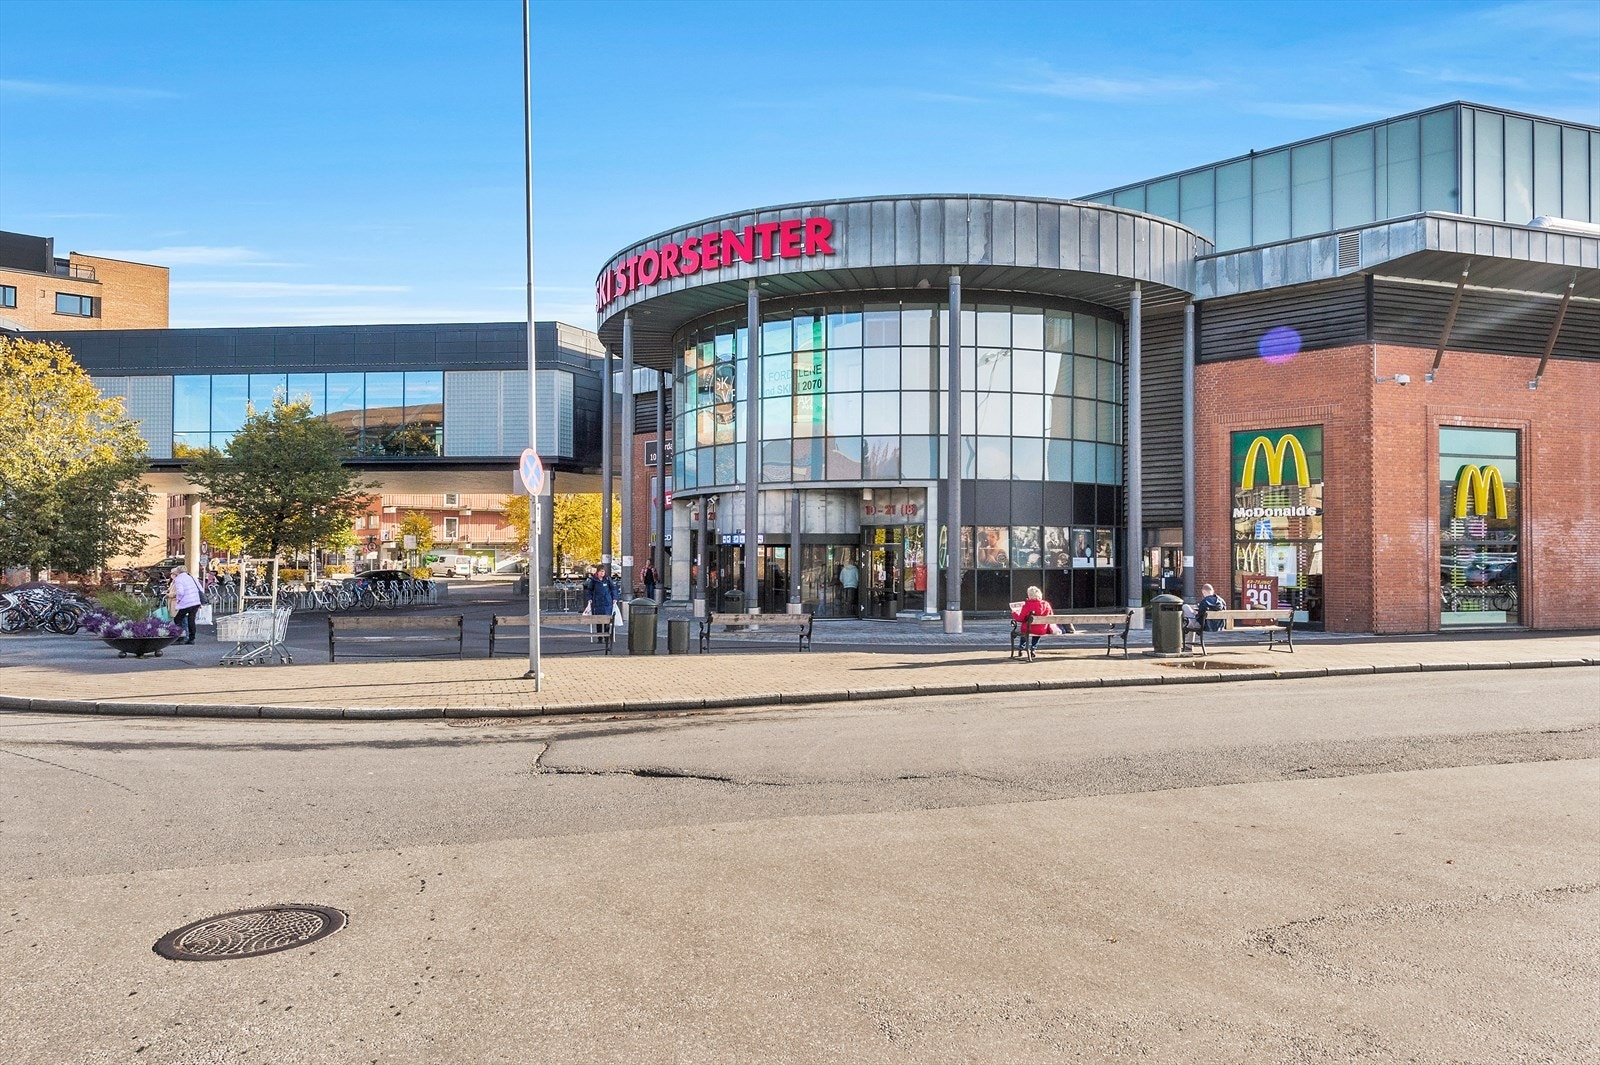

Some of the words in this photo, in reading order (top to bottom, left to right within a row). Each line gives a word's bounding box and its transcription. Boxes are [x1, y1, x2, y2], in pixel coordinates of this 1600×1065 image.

[595, 270, 614, 313] SKI
[615, 217, 835, 297] STORSENTER
[802, 379, 822, 391] 2070
[884, 505, 896, 516] 21
[900, 504, 918, 517] (18)
[1232, 506, 1317, 518] McDonald's
[1246, 589, 1272, 610] 39
